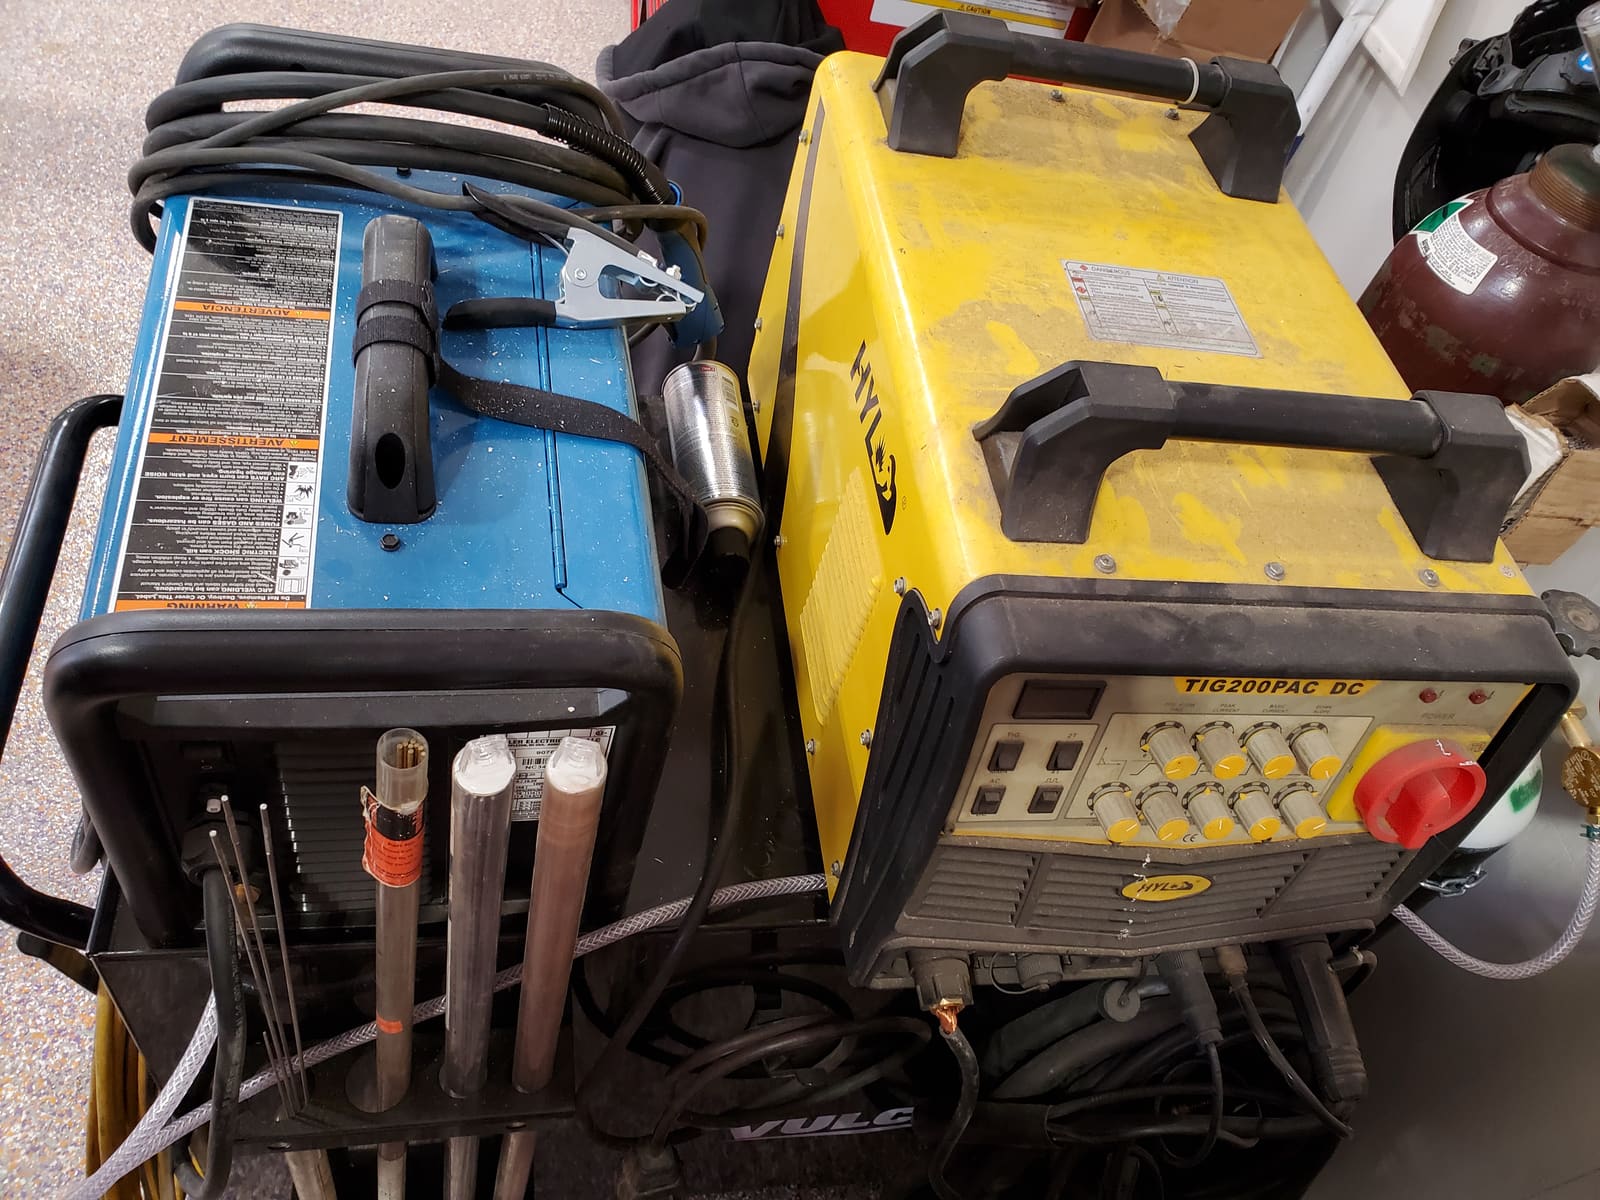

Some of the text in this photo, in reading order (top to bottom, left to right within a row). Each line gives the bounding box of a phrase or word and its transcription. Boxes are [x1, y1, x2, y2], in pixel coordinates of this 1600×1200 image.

[965, 5, 992, 16] CAUTION
[202, 304, 290, 316] ADVERTENCIA
[169, 435, 284, 447] AVERTISSEMENT
[1184, 678, 1364, 695] TIG200PAC DC
